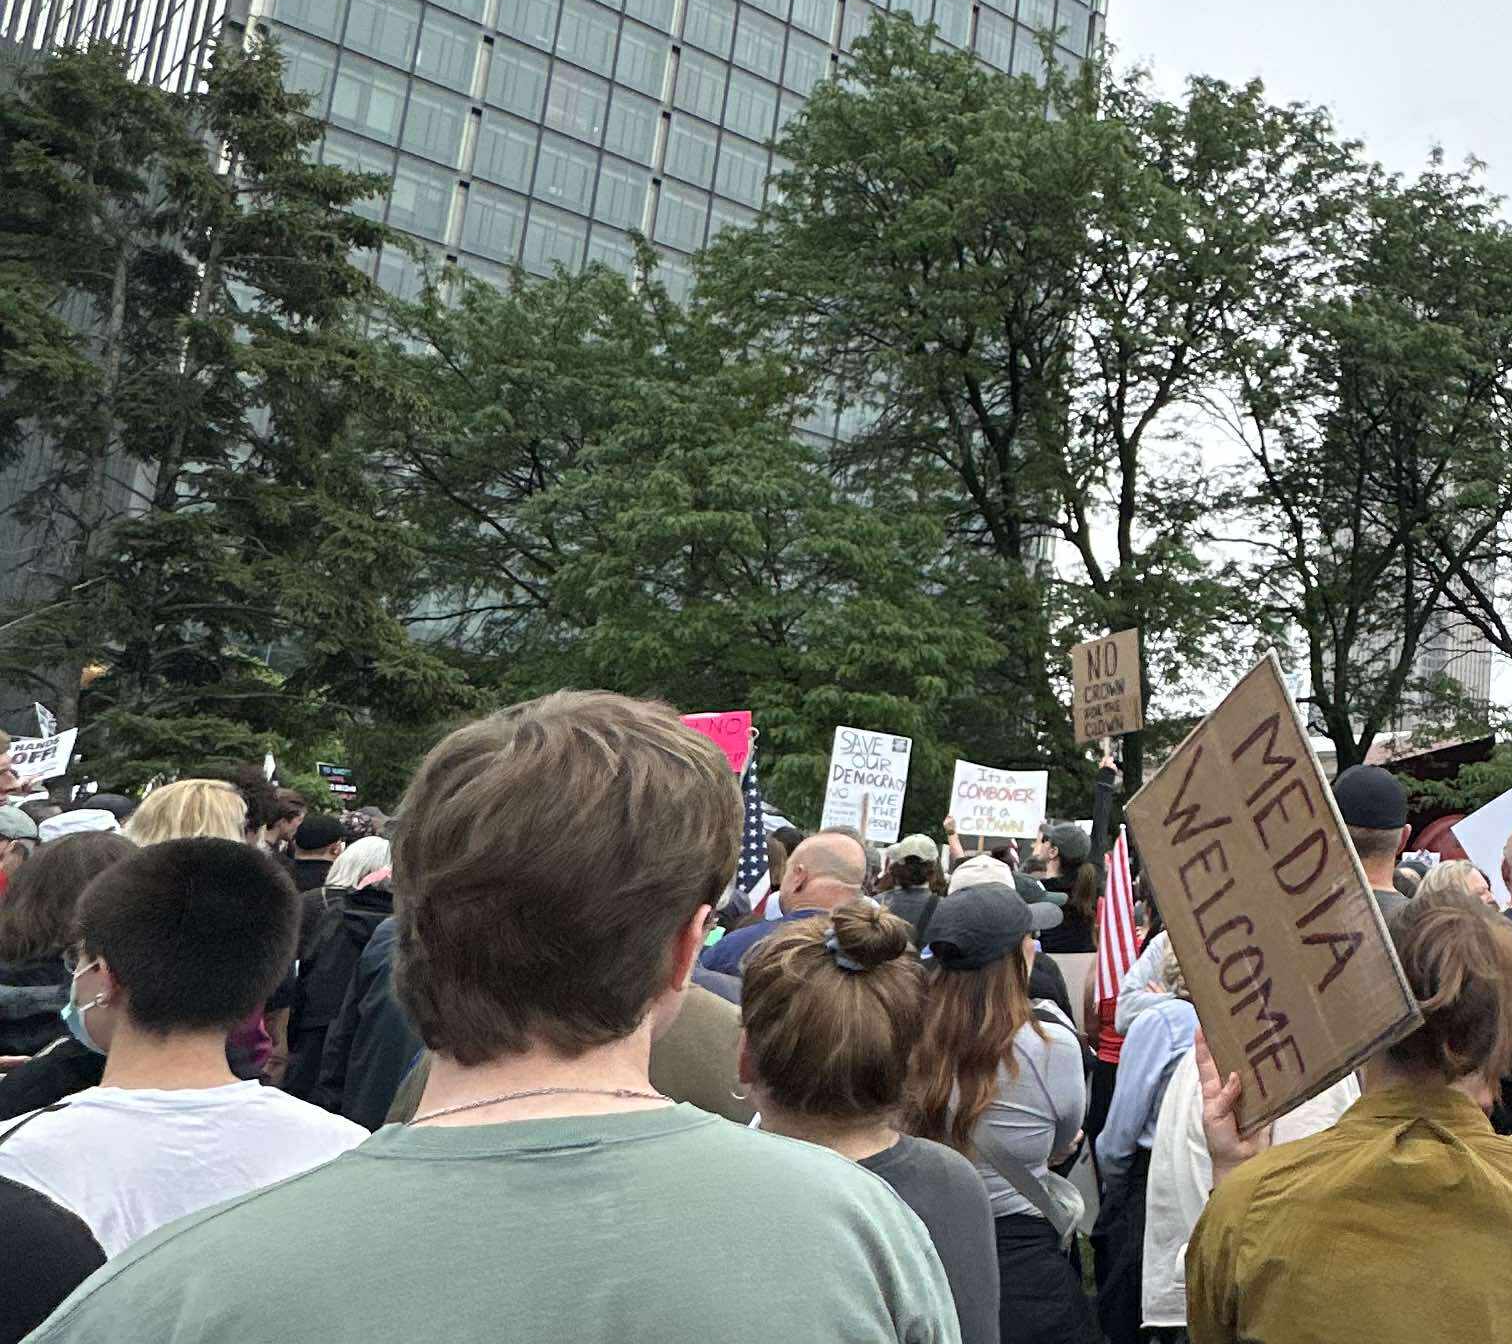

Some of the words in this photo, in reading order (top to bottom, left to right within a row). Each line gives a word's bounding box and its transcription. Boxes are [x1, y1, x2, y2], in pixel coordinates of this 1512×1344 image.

[1086, 641, 1118, 682] NO
[1084, 678, 1126, 704] CROWN
[840, 730, 884, 756] SAVE
[852, 755, 892, 772] OUR
[872, 792, 898, 806] WE
[957, 780, 1034, 804] COMBOVER
[872, 806, 898, 817] THE
[1231, 711, 1364, 995] MEDIA
[1162, 744, 1306, 1099] WELCOME
